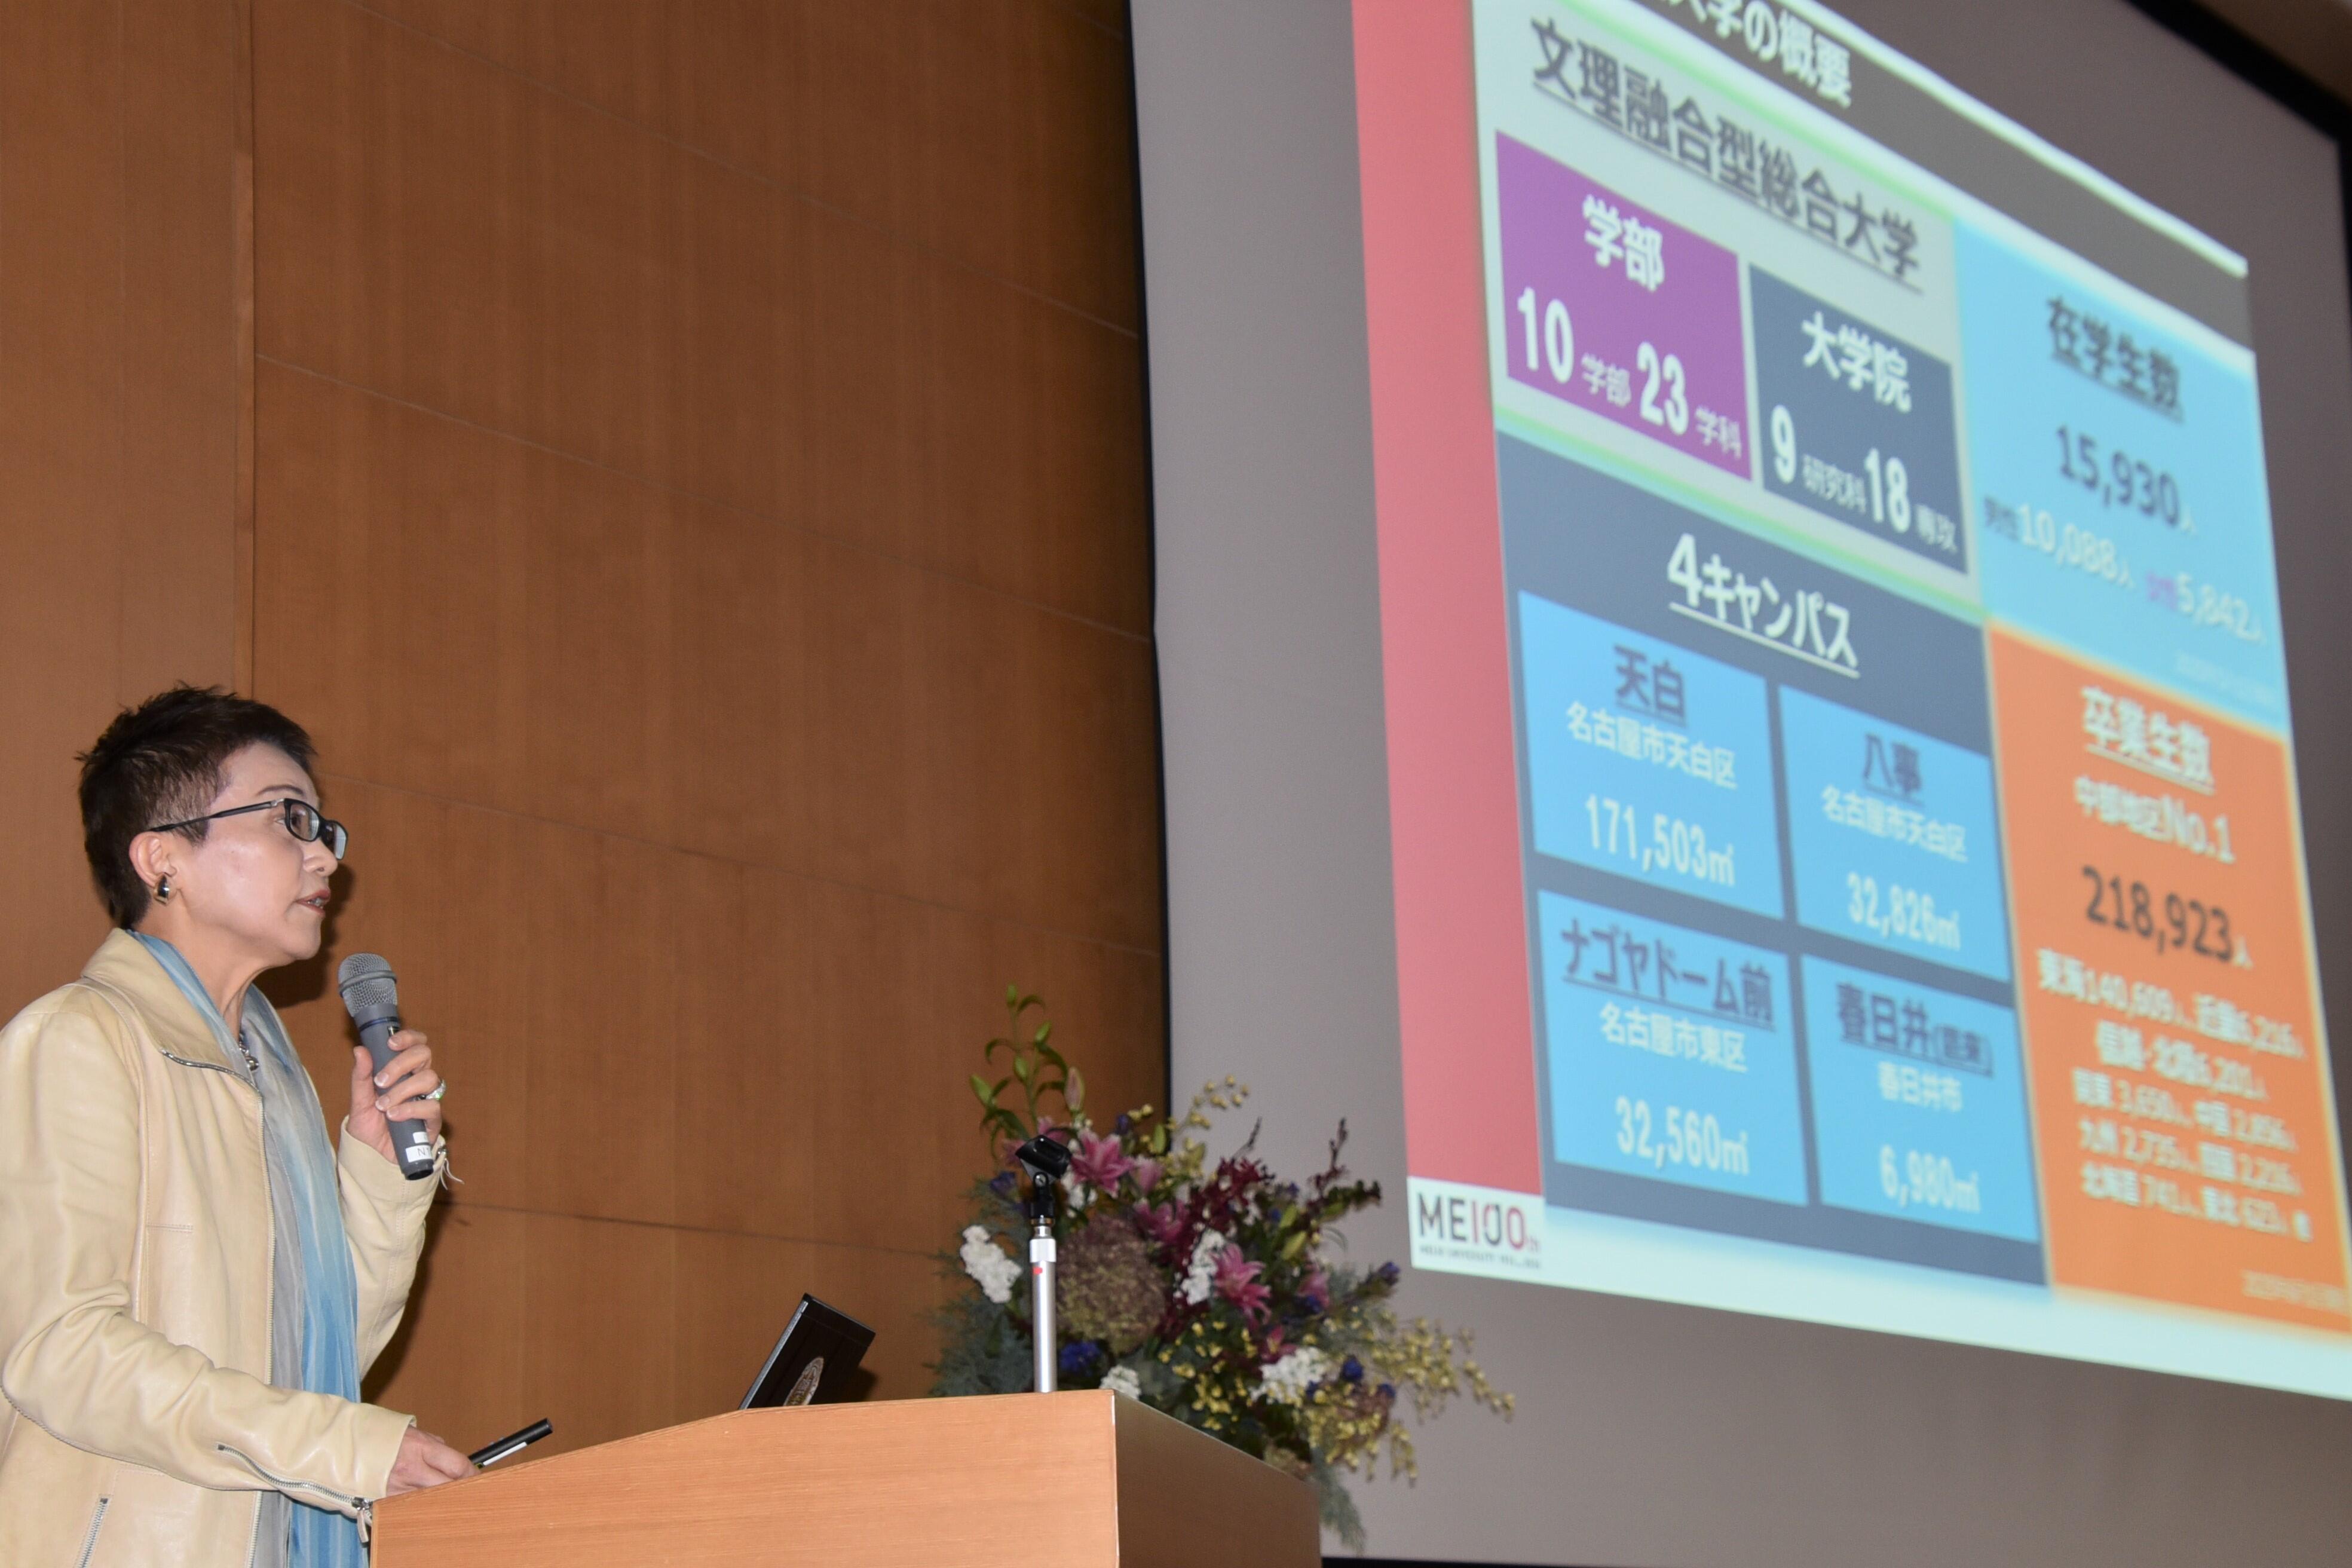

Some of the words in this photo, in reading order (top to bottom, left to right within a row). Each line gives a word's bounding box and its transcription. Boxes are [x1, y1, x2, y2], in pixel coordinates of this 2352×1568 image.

[1530, 18, 1921, 277] 文理融合型総合大学
[1583, 195, 1665, 291] 学部
[1801, 311, 1912, 412] 大学院
[2047, 295, 2180, 411] 在学生数
[1667, 533, 1858, 668] 4キャンパス
[1613, 644, 1685, 717] 天白
[1566, 701, 1738, 789] 名古屋市天白区
[1863, 733, 1923, 800] 八事
[1820, 785, 1969, 863] 名古屋市天白区
[1560, 918, 1774, 1023] ナゴヤドーム前
[1599, 1002, 1748, 1073] 名古屋市東区
[1878, 1061, 1963, 1113] 春日井市
